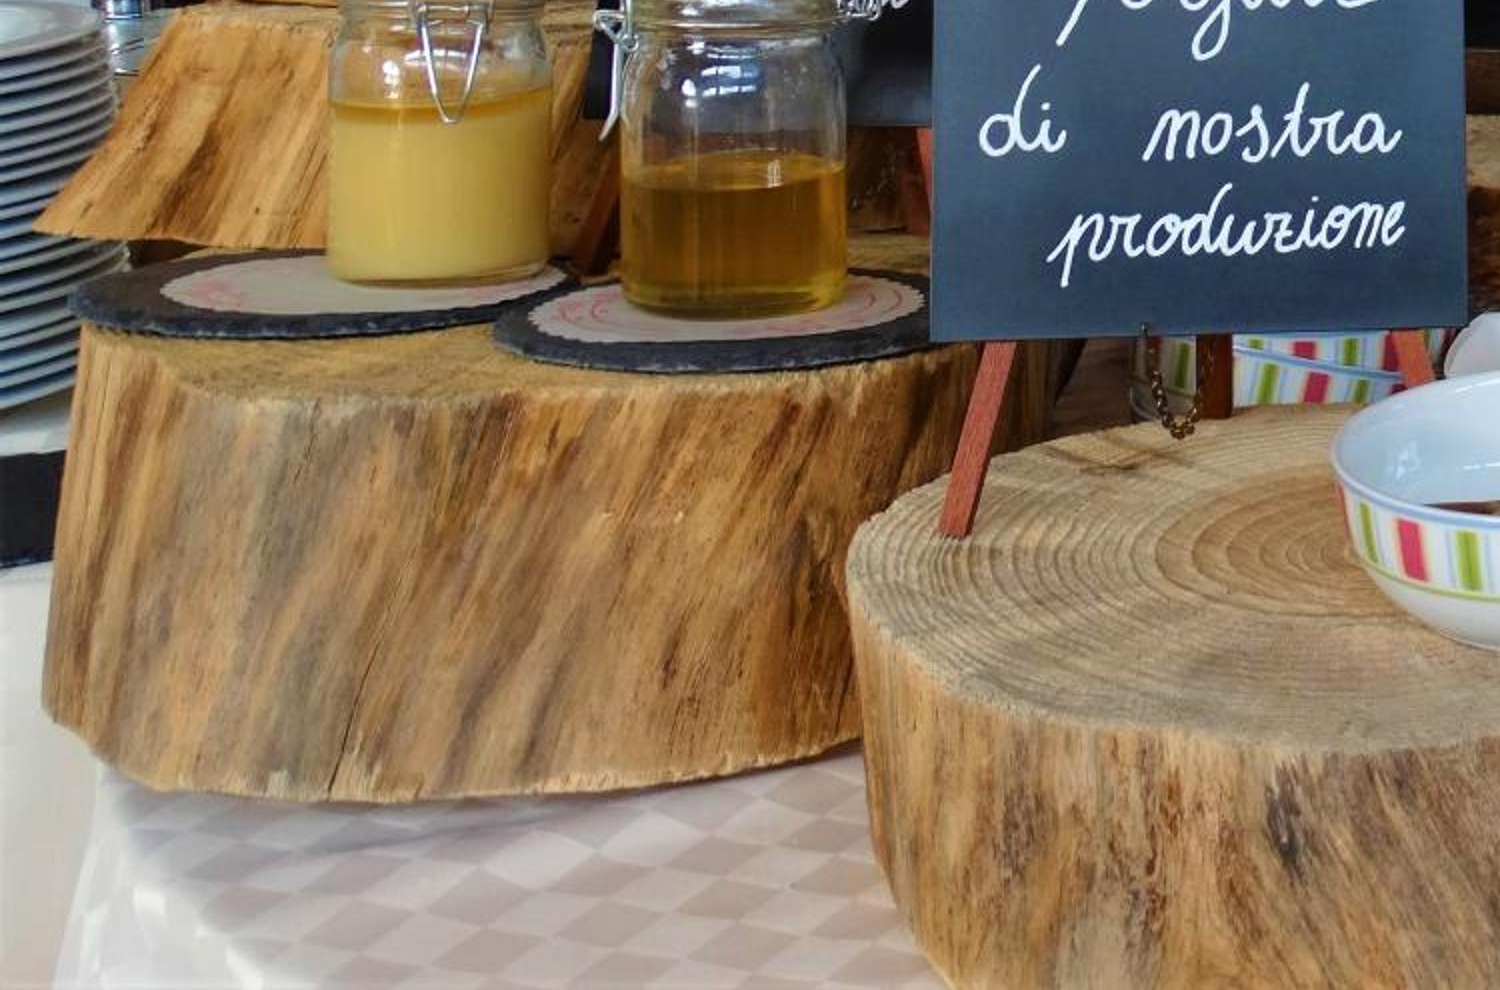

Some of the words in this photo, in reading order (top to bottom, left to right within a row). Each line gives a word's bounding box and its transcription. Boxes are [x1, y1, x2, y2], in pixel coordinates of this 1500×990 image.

[978, 63, 1067, 157] di
[1142, 81, 1403, 163] nostra
[1046, 182, 1406, 288] produzione
